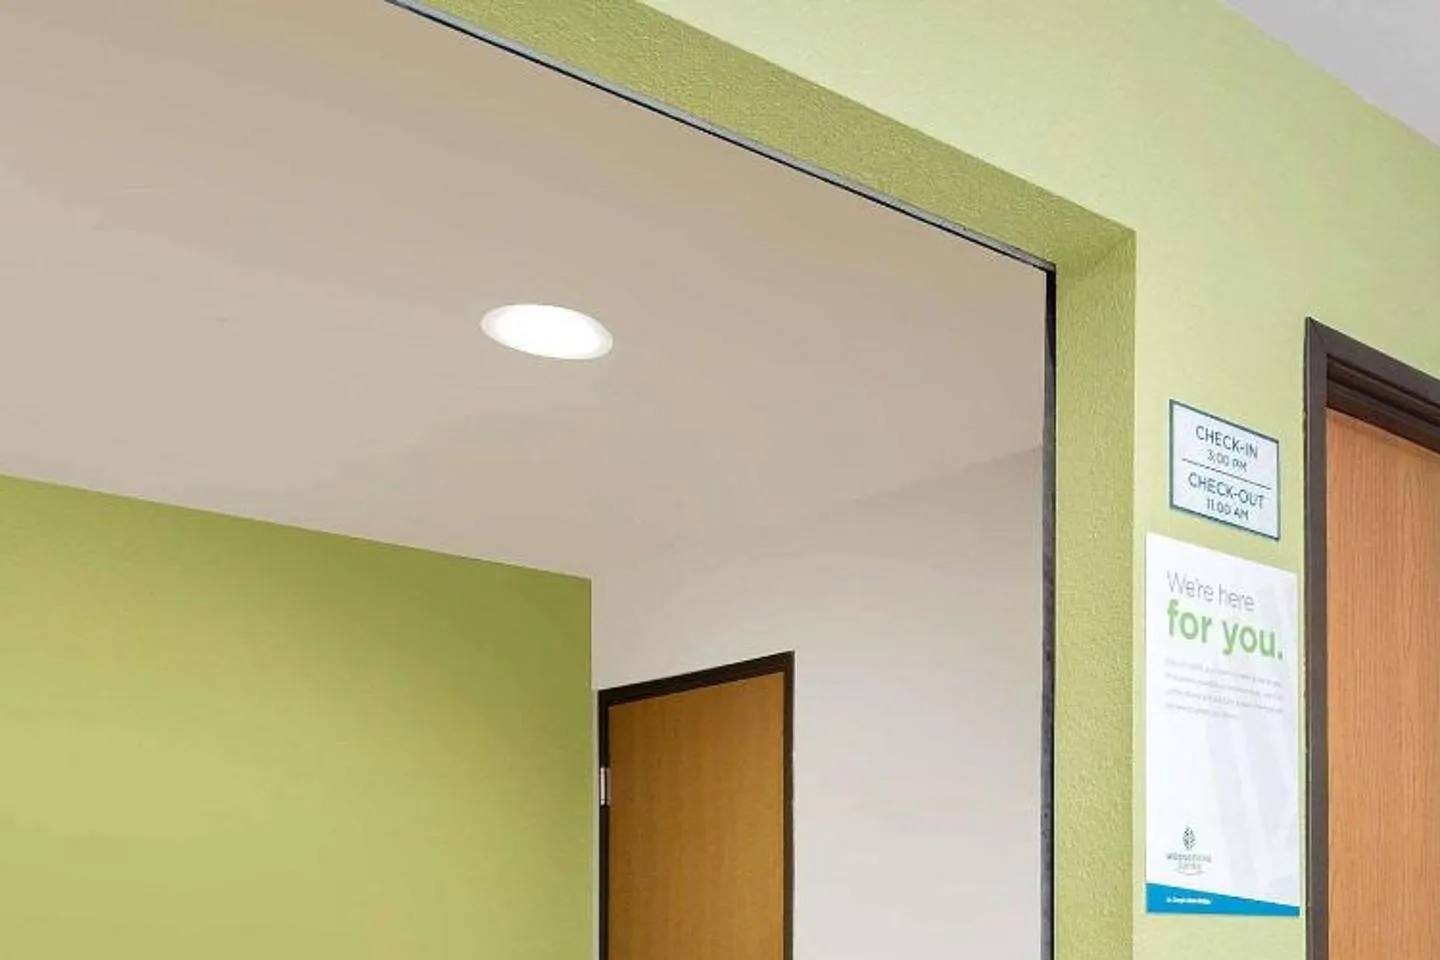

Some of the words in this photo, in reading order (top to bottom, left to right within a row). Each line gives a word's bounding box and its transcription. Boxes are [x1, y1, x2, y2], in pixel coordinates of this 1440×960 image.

[1195, 425, 1259, 459] CHECK-IN
[1232, 457, 1248, 472] PM
[1188, 471, 1265, 510] CHECK-OUT
[1234, 506, 1249, 520] AM
[1218, 583, 1255, 612] here
[1166, 599, 1213, 644] for
[1221, 620, 1284, 661] you.
